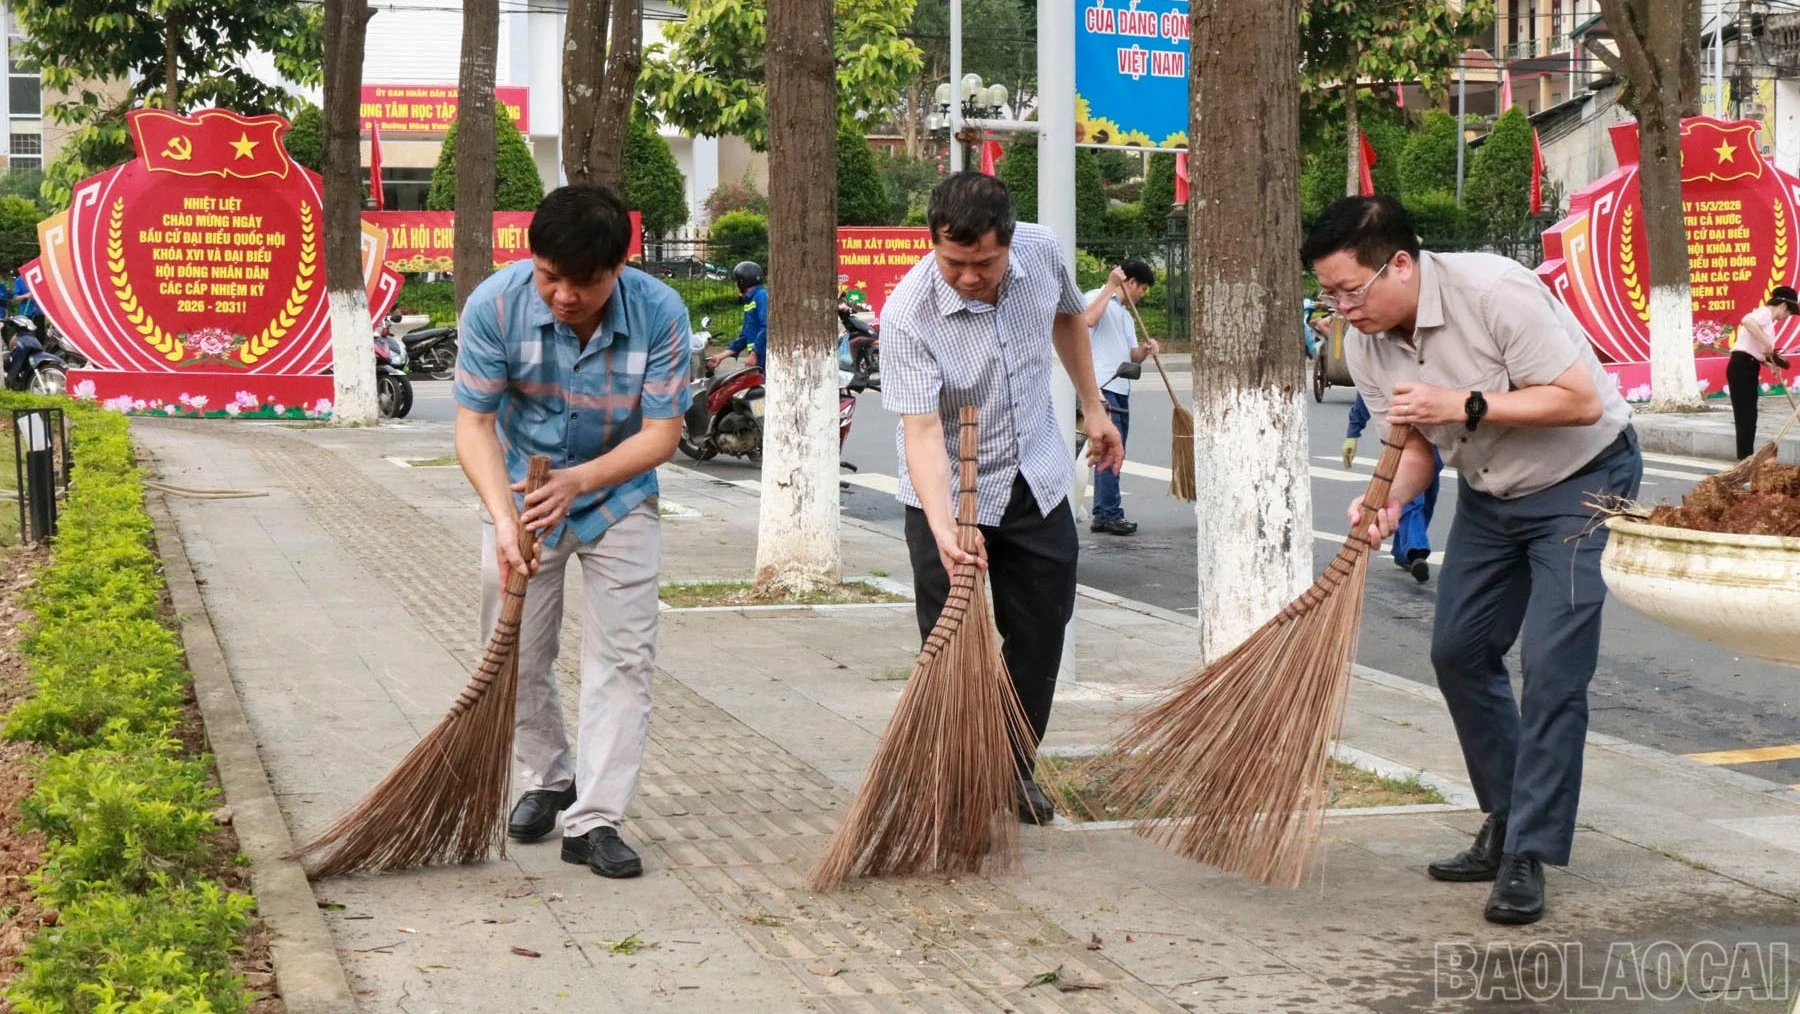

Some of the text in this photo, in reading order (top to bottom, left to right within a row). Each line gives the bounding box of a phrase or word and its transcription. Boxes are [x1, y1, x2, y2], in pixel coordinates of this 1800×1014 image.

[1085, 0, 1190, 44] CỦA ĐẢNG CỘN
[1117, 44, 1184, 80] VIỆT NAM
[388, 89, 404, 97] BAN
[360, 103, 382, 118] UNG
[385, 101, 408, 119] TÂM
[411, 103, 433, 121] HỌC
[436, 101, 456, 121] TẬP
[184, 196, 242, 213] NHIỆT LIỆT
[1695, 200, 1742, 212] 15/3/2026
[163, 213, 262, 228] CHÀO MỪNG NGÀY
[1700, 212, 1713, 226] CẢ
[1715, 212, 1742, 225] NƯỚC
[140, 227, 285, 248] BẦU CỬ ĐẠI BIỂU QUỐC HỘI
[392, 224, 408, 248] XÃ
[410, 223, 430, 254] HỘI
[497, 223, 521, 253] VIỆT
[1693, 227, 1707, 240] CỬ
[1709, 229, 1725, 241] ĐẠI
[1728, 225, 1750, 239] BIỂU
[842, 237, 862, 249] TÂM
[864, 237, 882, 249] XÂY
[885, 238, 911, 251] DỰNG
[913, 237, 926, 249] XÃ
[1688, 241, 1750, 256] HỘI KHÓA XVI
[153, 246, 272, 264] KHÓA XVI VÀ ĐẠI BIỂU
[840, 253, 920, 265] THÀNH XÃ KHÔNG
[1711, 256, 1727, 271] HỘI
[1730, 254, 1756, 267] ĐỒNG
[156, 262, 269, 280] HỘI ĐỒNG NHÂN DÂN
[1710, 270, 1730, 282] CÁC
[1732, 267, 1752, 281] CẤP
[160, 279, 264, 298] CÁC CẤP NHIỆM KỲ
[1691, 284, 1728, 299] HIỆM KỲ
[177, 300, 205, 312] 2026
[215, 301, 246, 313] 2031!
[1708, 300, 1735, 311] 2031!
